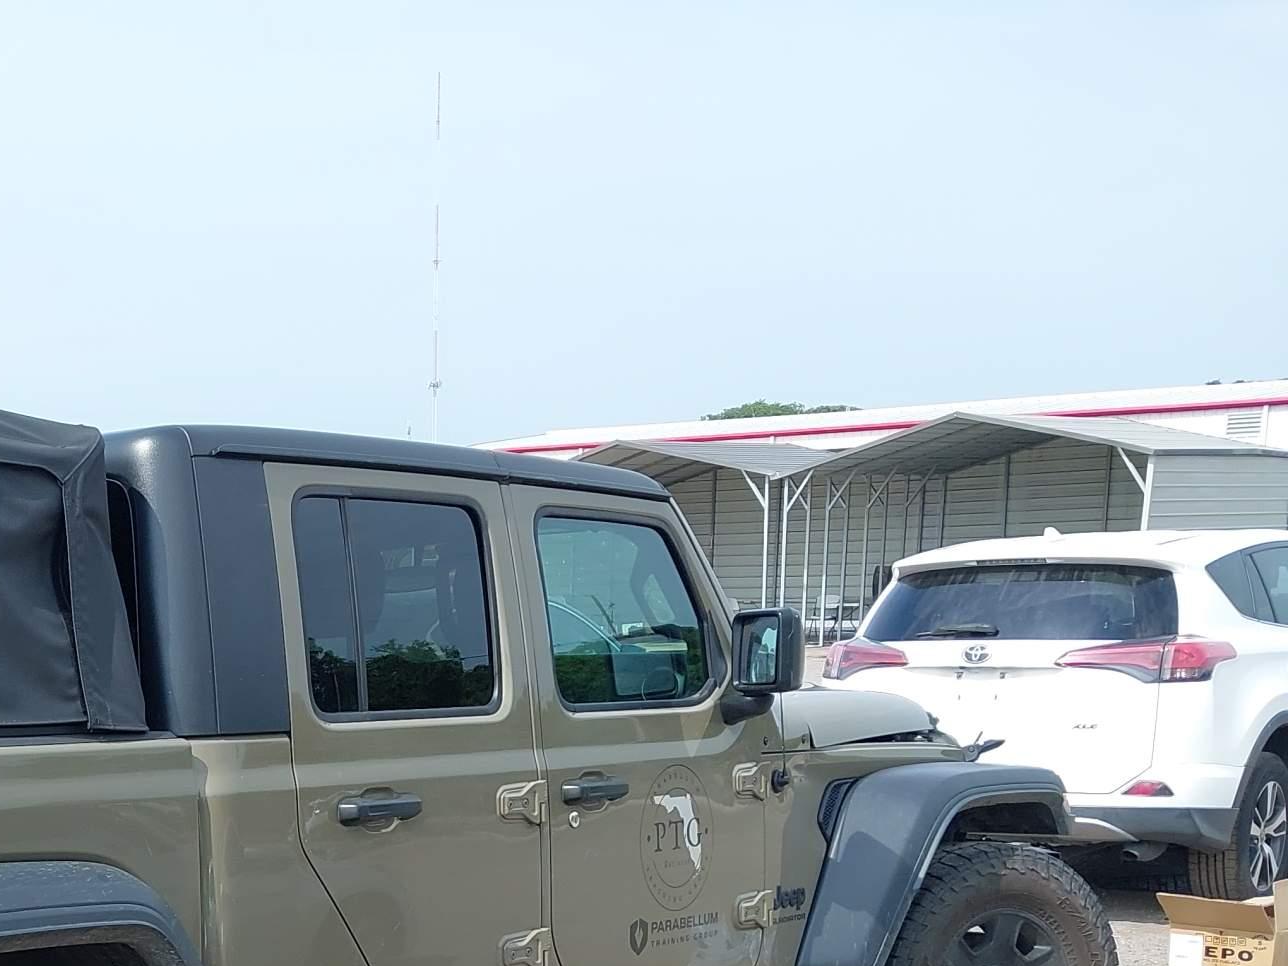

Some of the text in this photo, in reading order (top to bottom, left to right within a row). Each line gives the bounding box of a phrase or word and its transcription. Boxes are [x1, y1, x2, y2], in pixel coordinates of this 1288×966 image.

[654, 817, 702, 853] PTG
[773, 885, 806, 911] Jeep
[650, 911, 719, 934] PARABELLUM
[650, 934, 690, 948] TRAINING
[1204, 945, 1253, 962] EPO
